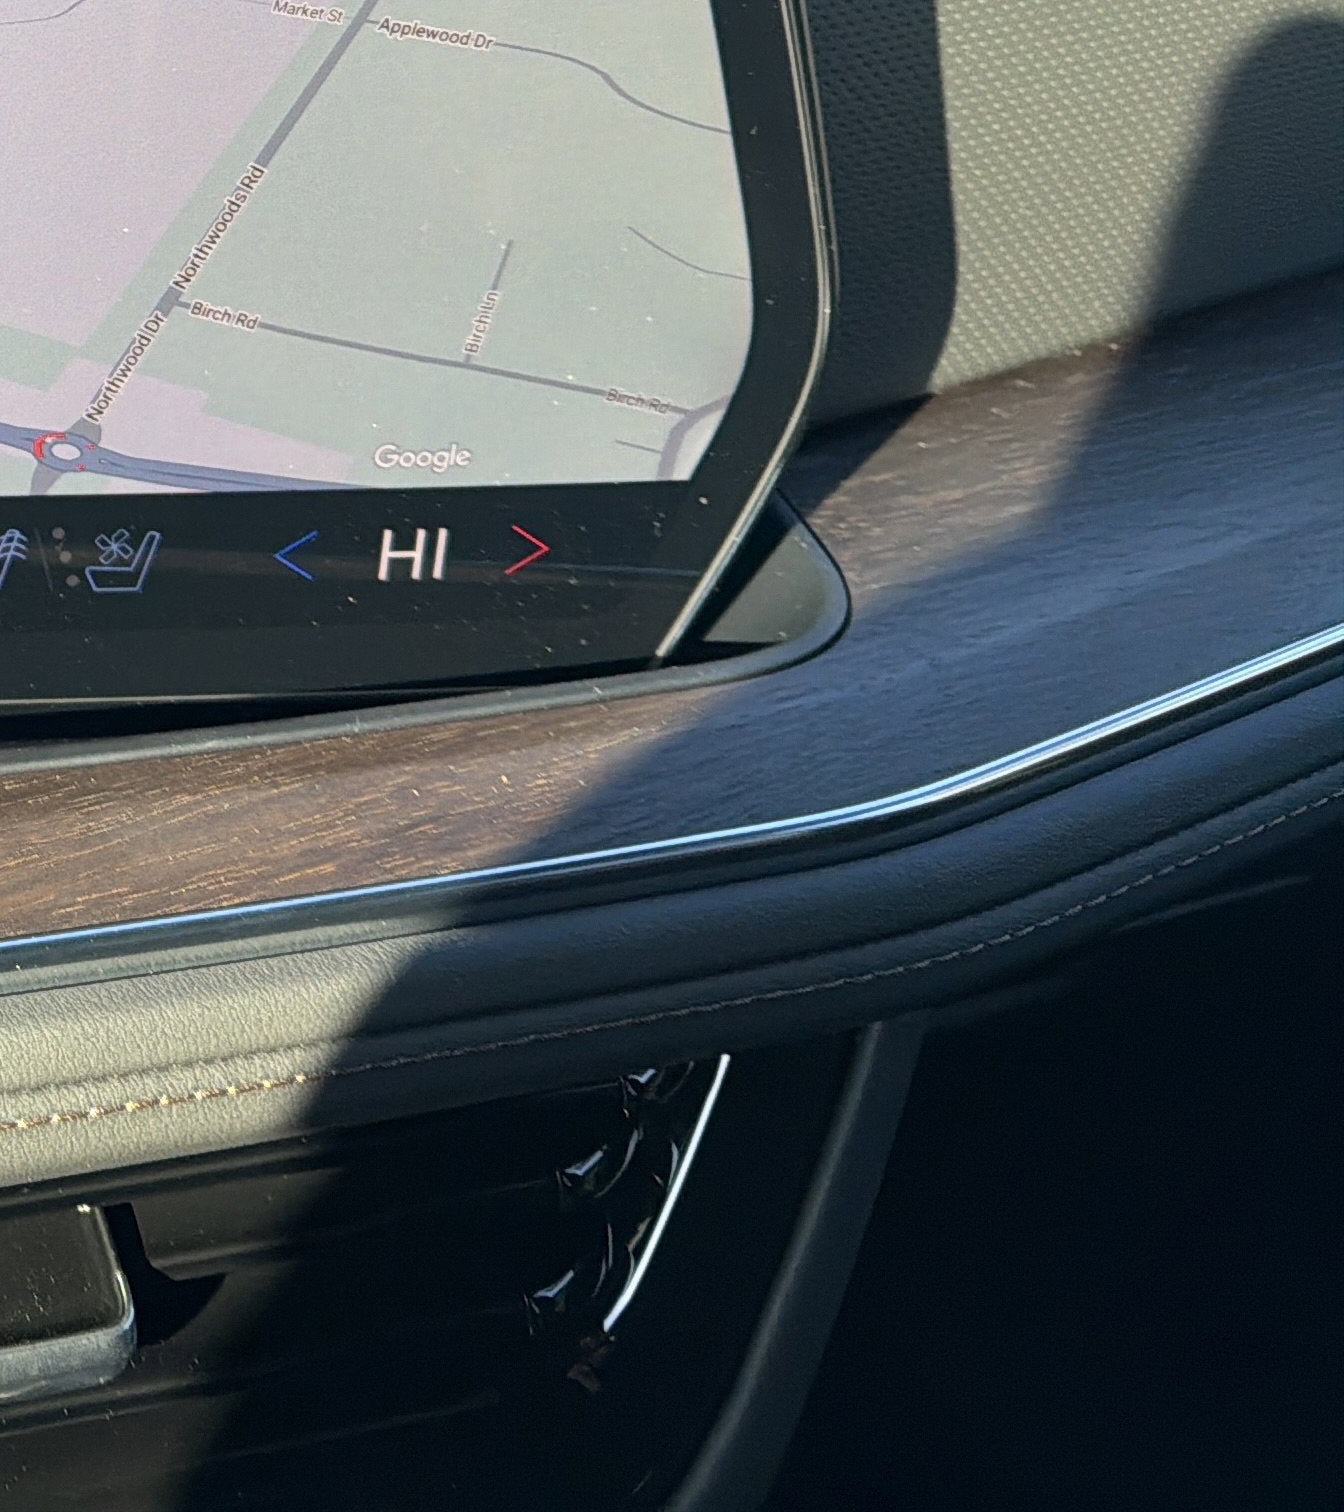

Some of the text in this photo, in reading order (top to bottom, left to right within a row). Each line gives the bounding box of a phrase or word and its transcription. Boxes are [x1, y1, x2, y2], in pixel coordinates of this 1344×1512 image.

[273, 0, 343, 22] Market St
[378, 17, 493, 49] Applewood Dr
[172, 166, 266, 290] Northwoods Rd
[191, 302, 258, 329] Birch Rd
[464, 292, 498, 353] Birch Ln
[87, 313, 165, 423] Northwood Dr
[606, 389, 669, 413] Birch Rd
[375, 445, 471, 471] Google
[377, 528, 448, 582] HI
